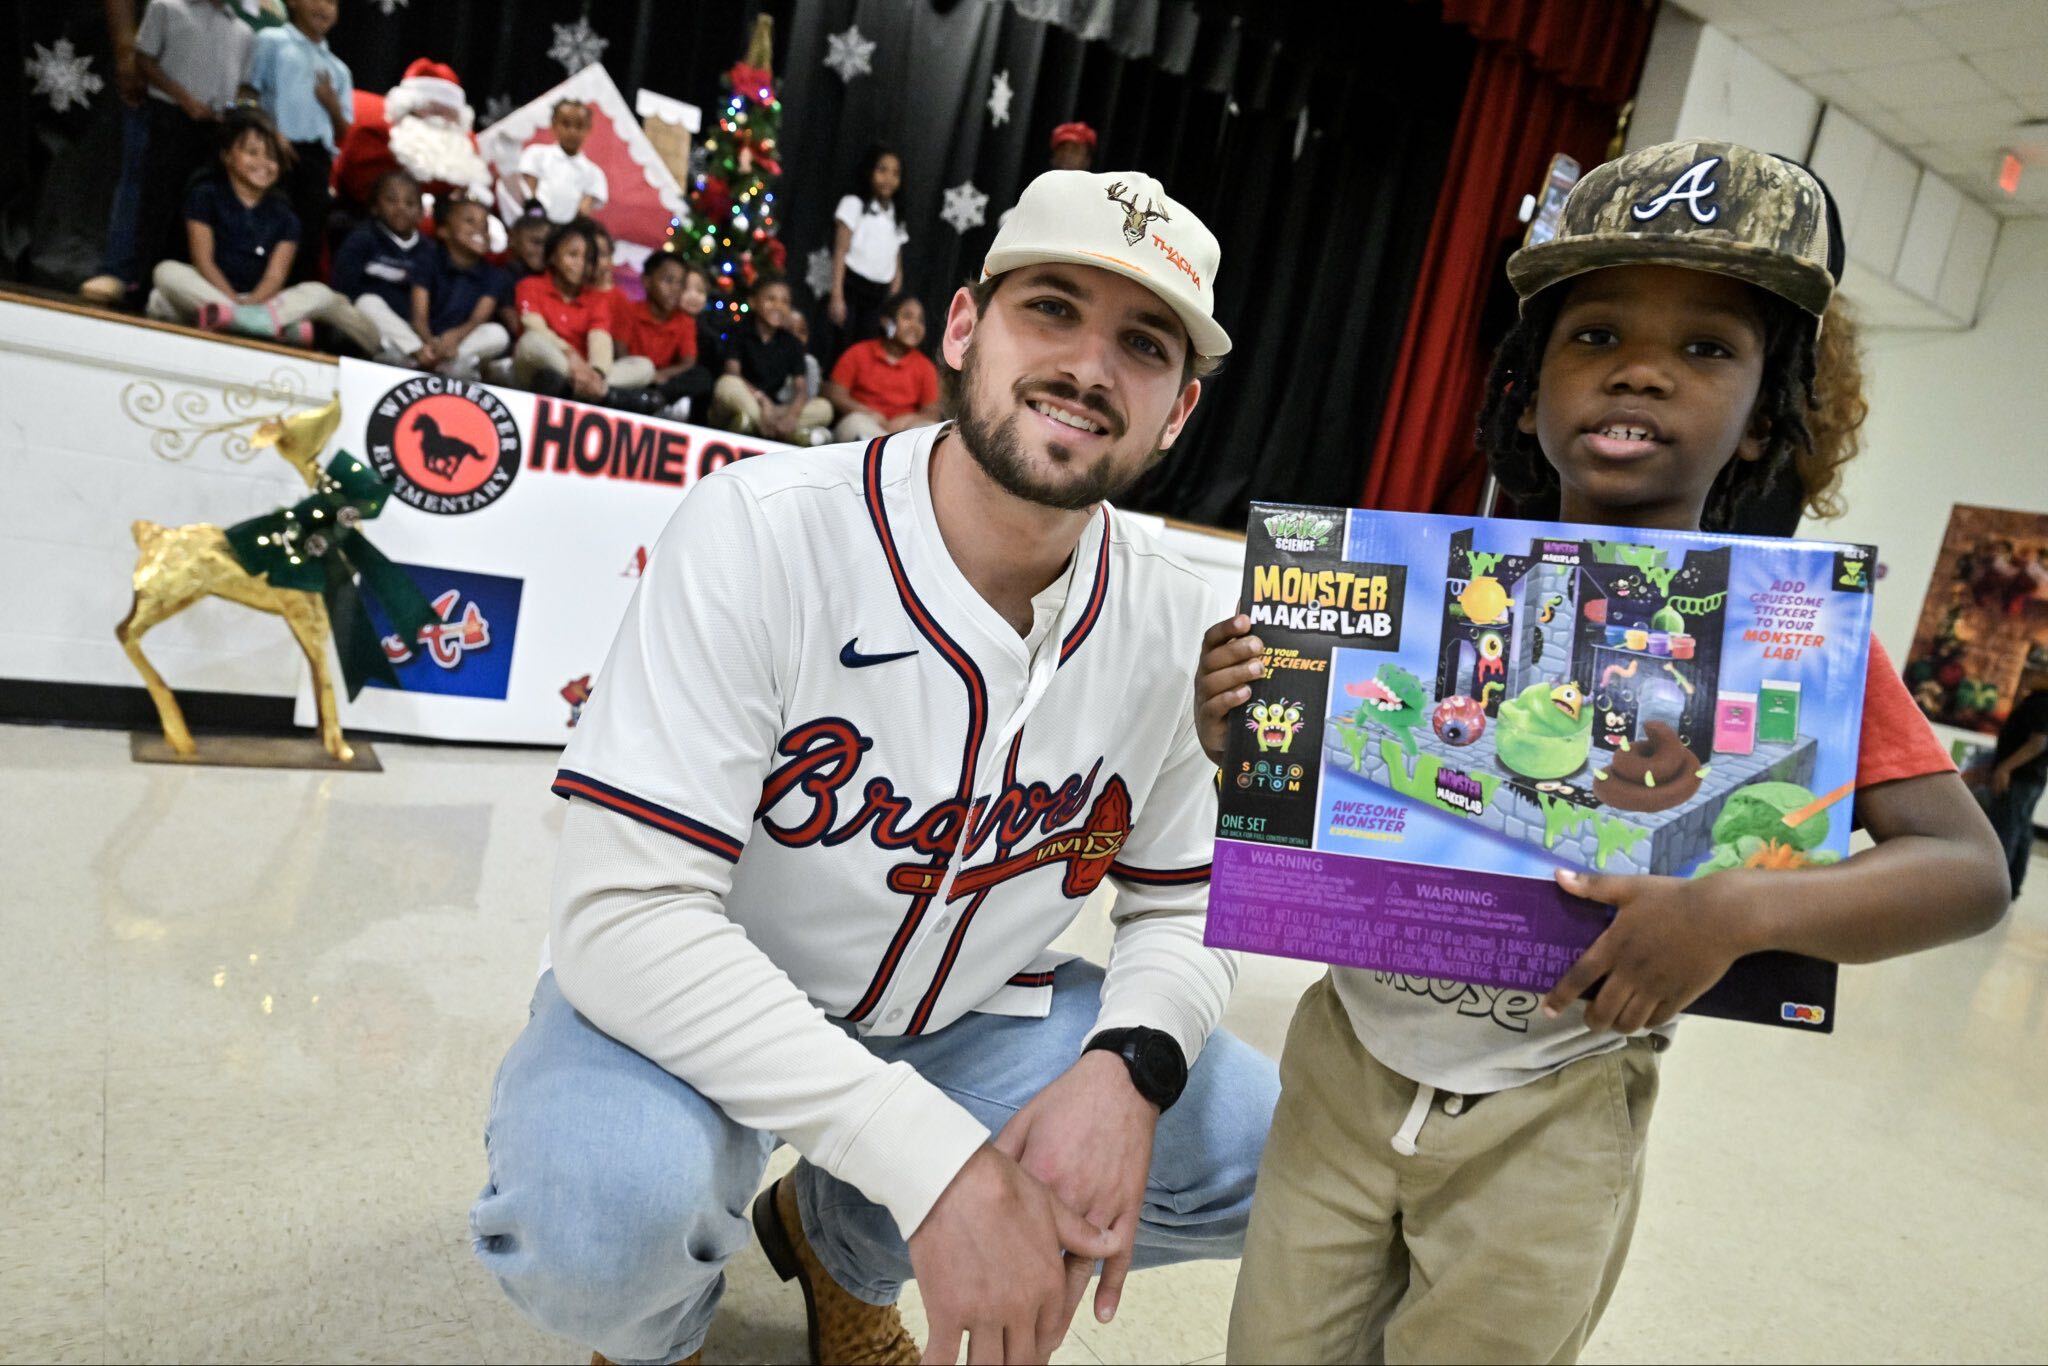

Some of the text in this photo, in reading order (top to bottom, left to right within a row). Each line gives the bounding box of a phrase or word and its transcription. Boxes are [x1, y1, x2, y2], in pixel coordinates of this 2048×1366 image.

[1630, 155, 1723, 225] A
[378, 376, 518, 452] WINCHESTER
[527, 393, 690, 488] HOME
[372, 444, 509, 512] ELEMENTARY
[1274, 538, 1316, 553] SCIENCE
[1253, 564, 1389, 612] MONSTER
[1770, 580, 1806, 593] ADD
[1751, 592, 1825, 609] GRUESOME
[1753, 604, 1818, 620] STICKERS
[1756, 617, 1814, 631] TO YOUR
[1742, 629, 1825, 649] MONSTER
[1274, 647, 1299, 658] YOUR
[1762, 646, 1803, 661] LAB!
[1271, 656, 1328, 673] SCIENCE
[754, 716, 1104, 862] Braves
[1438, 768, 1482, 798] MONSTER
[1331, 800, 1408, 820] AWESOME
[1221, 814, 1267, 832] ONE SET
[1331, 813, 1406, 833] MONSTER
[1250, 850, 1324, 872] WARNING
[1416, 884, 1498, 908] WARNING:
[1275, 908, 1292, 922] NET
[1404, 925, 1422, 940] NET
[1533, 943, 1546, 957] OF
[1309, 927, 1342, 944] STARCH
[1496, 953, 1521, 968] CLAY
